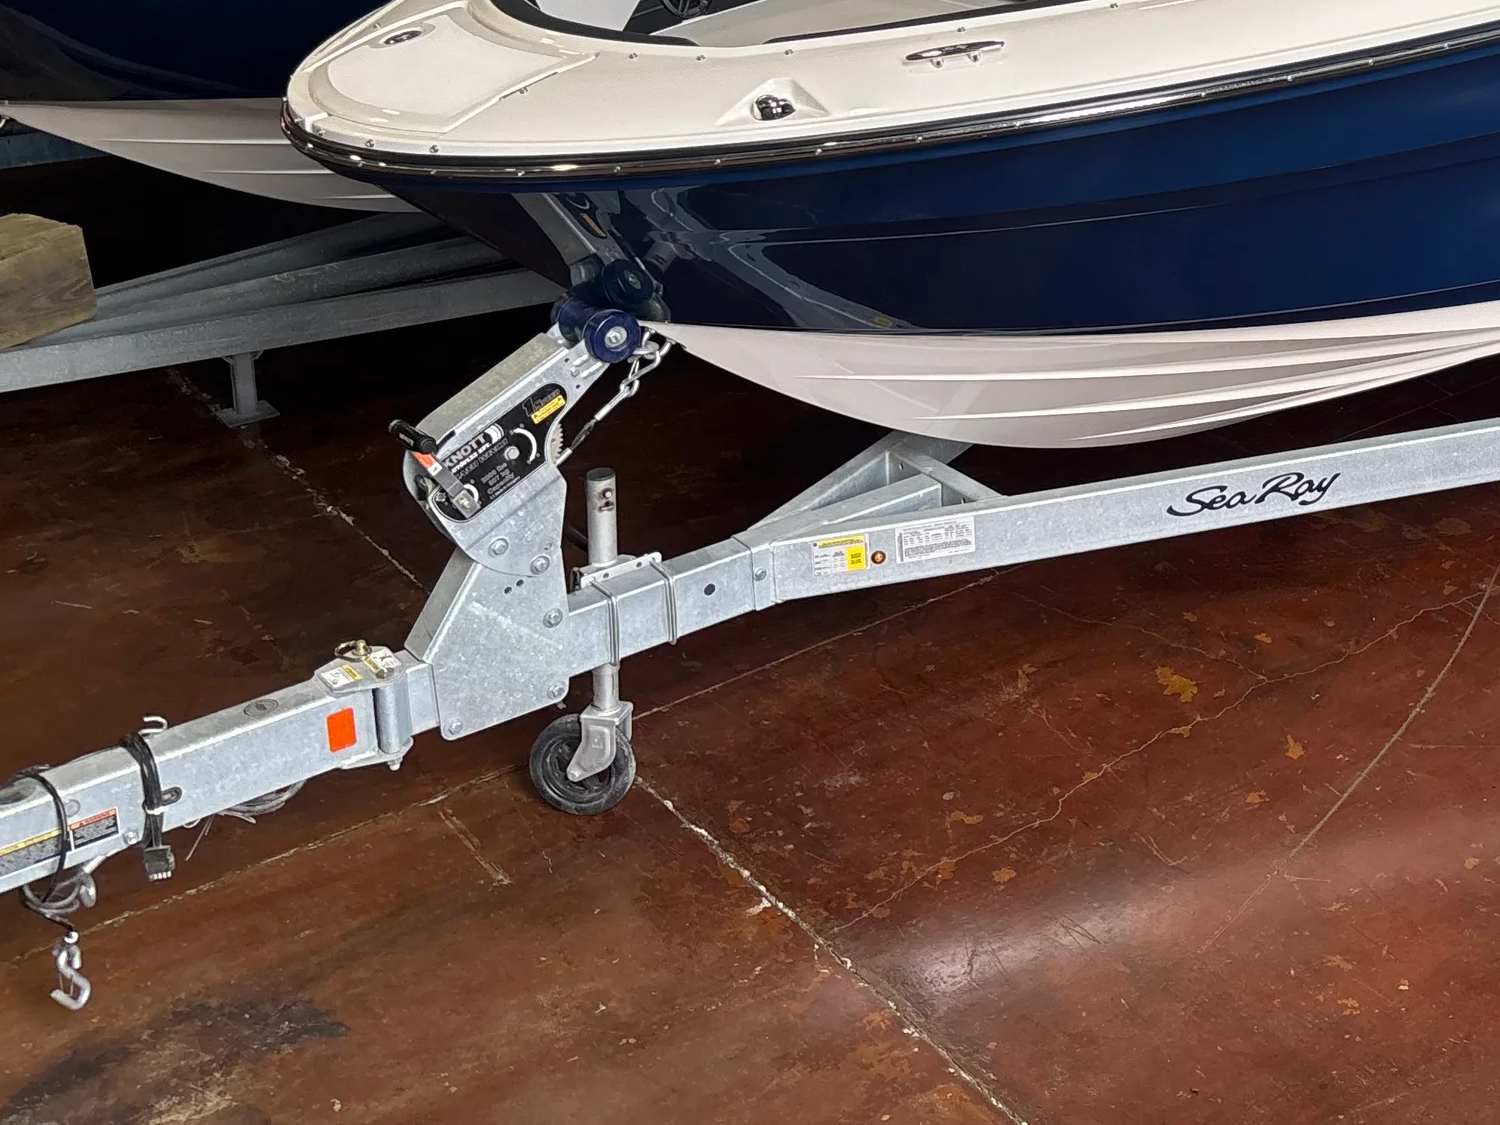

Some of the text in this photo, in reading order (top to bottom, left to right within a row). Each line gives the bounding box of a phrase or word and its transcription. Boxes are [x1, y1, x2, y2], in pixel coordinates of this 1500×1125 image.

[443, 432, 487, 468] KNOTT
[1166, 472, 1342, 517] Sea Ray
